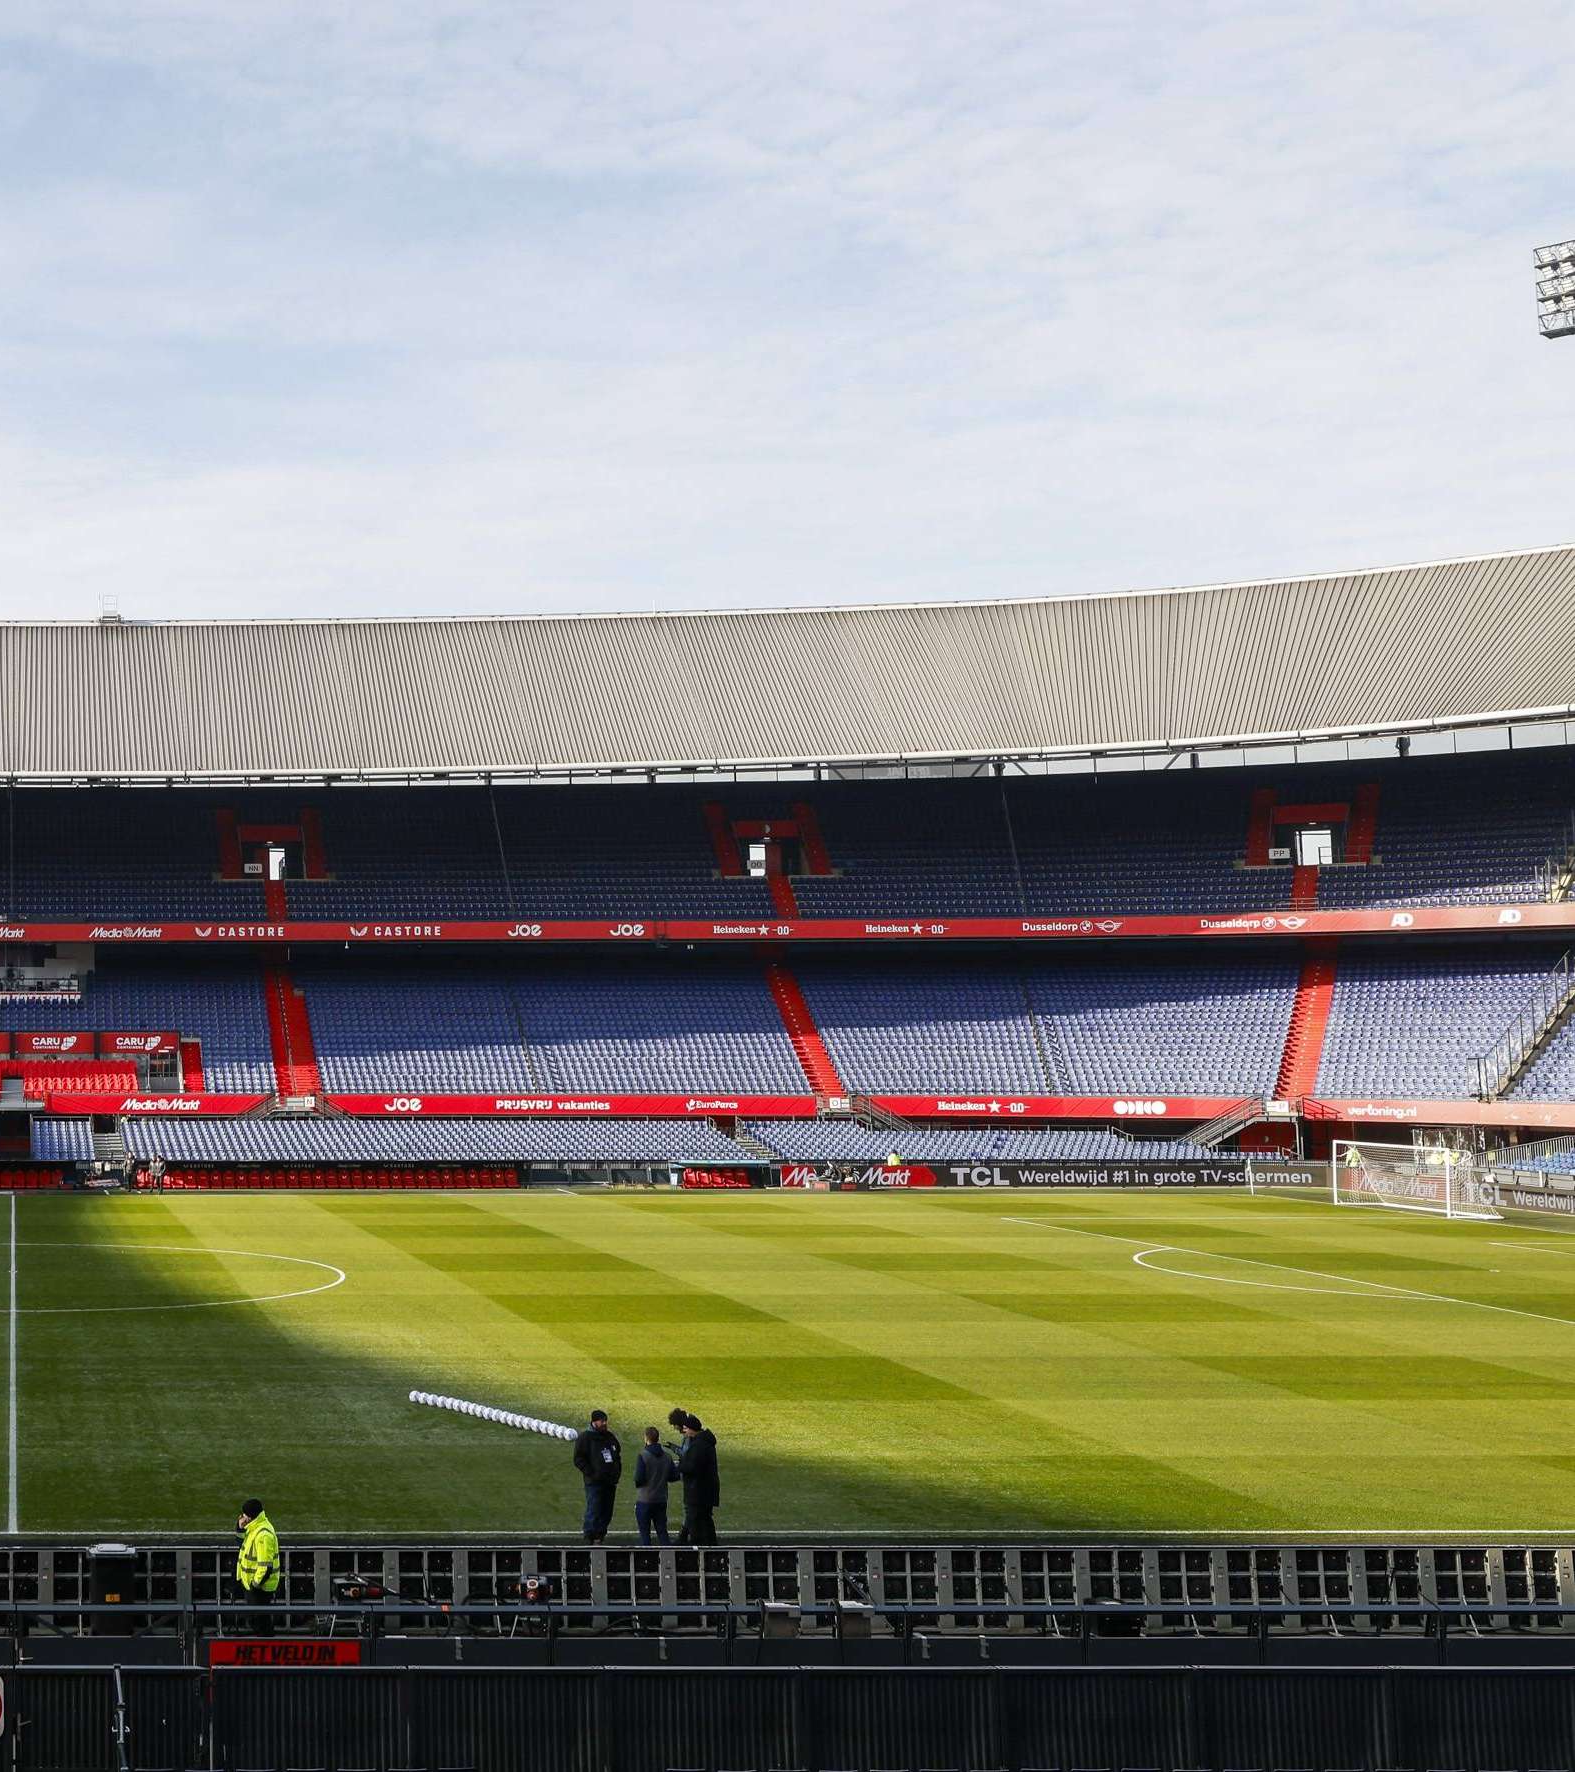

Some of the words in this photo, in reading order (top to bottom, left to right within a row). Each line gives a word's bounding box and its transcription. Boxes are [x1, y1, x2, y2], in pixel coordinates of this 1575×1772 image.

[508, 924, 542, 936] JOE
[610, 924, 644, 936] JOE
[713, 925, 756, 934] Heineken
[866, 925, 909, 933] Heineken
[1023, 922, 1078, 933] Dusseldorp
[1200, 919, 1260, 930] Dusseldorp
[89, 927, 123, 938] Media
[131, 927, 161, 938] Markt
[218, 927, 284, 936] CASTORE
[375, 926, 441, 936] CASTORE
[32, 1037, 60, 1046] CARU
[116, 1037, 144, 1046] CARU
[120, 1098, 158, 1111] Media
[167, 1099, 200, 1111] Markt
[384, 1098, 422, 1111] JOE
[557, 1100, 610, 1110] vakanties
[696, 1100, 738, 1110] EuroParcs
[937, 1101, 986, 1111] Heineken
[859, 1166, 910, 1186] Markt
[950, 1167, 1010, 1186] TCL
[1019, 1170, 1107, 1185] Wereldwijd
[1113, 1170, 1129, 1183] #1
[1135, 1169, 1148, 1183] in
[1154, 1171, 1195, 1186] grote
[1200, 1169, 1312, 1184] TV-schermen
[1512, 1189, 1575, 1214] Wereldwij
